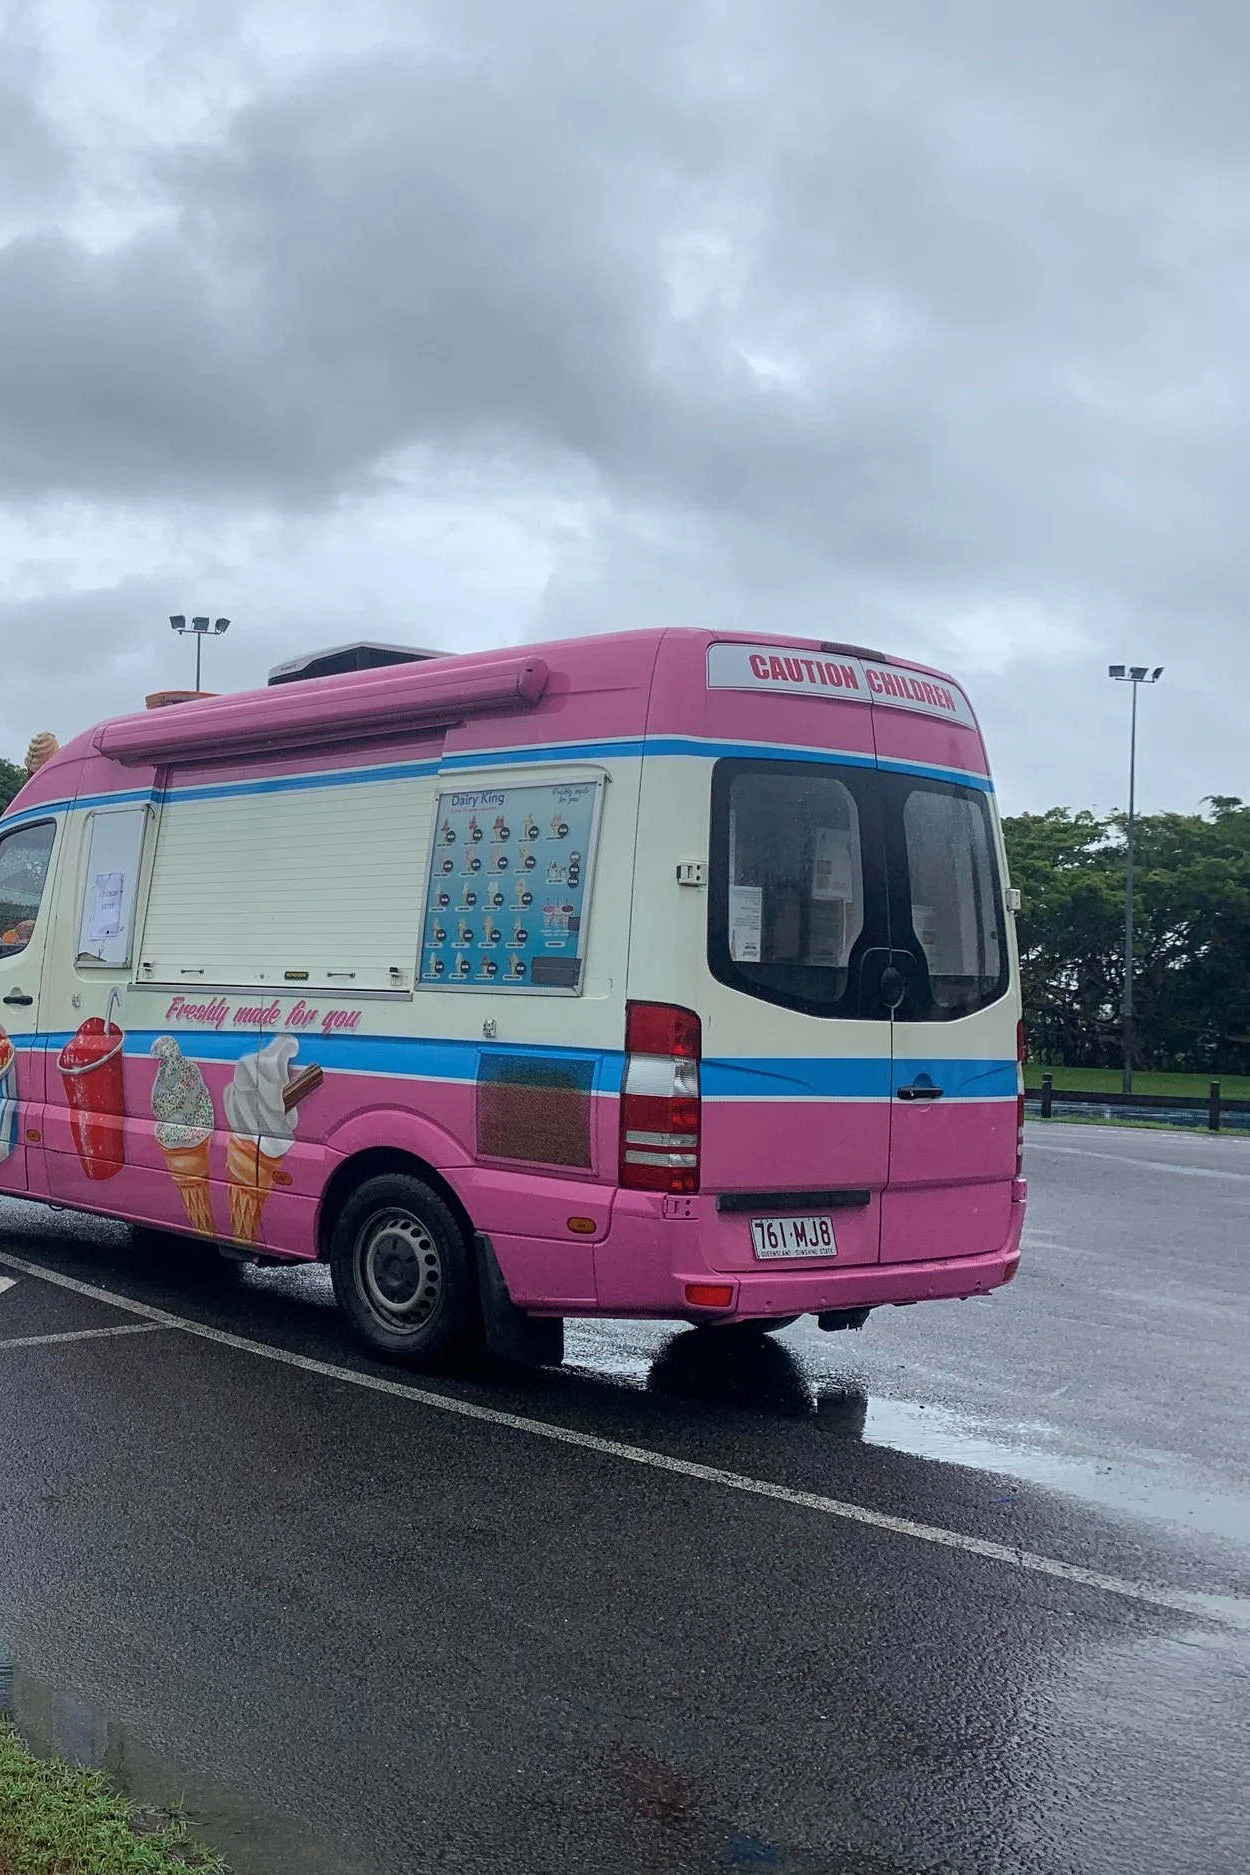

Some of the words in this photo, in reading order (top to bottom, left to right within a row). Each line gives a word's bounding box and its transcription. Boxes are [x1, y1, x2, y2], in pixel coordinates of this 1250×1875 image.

[750, 654, 860, 690] CAUTION
[865, 669, 956, 712] CHILDREN
[451, 793, 479, 808] Dairy
[481, 791, 505, 805] King
[165, 996, 230, 1030] Freshly
[233, 1000, 281, 1025] made
[285, 1000, 318, 1026] for
[322, 1009, 362, 1036] you
